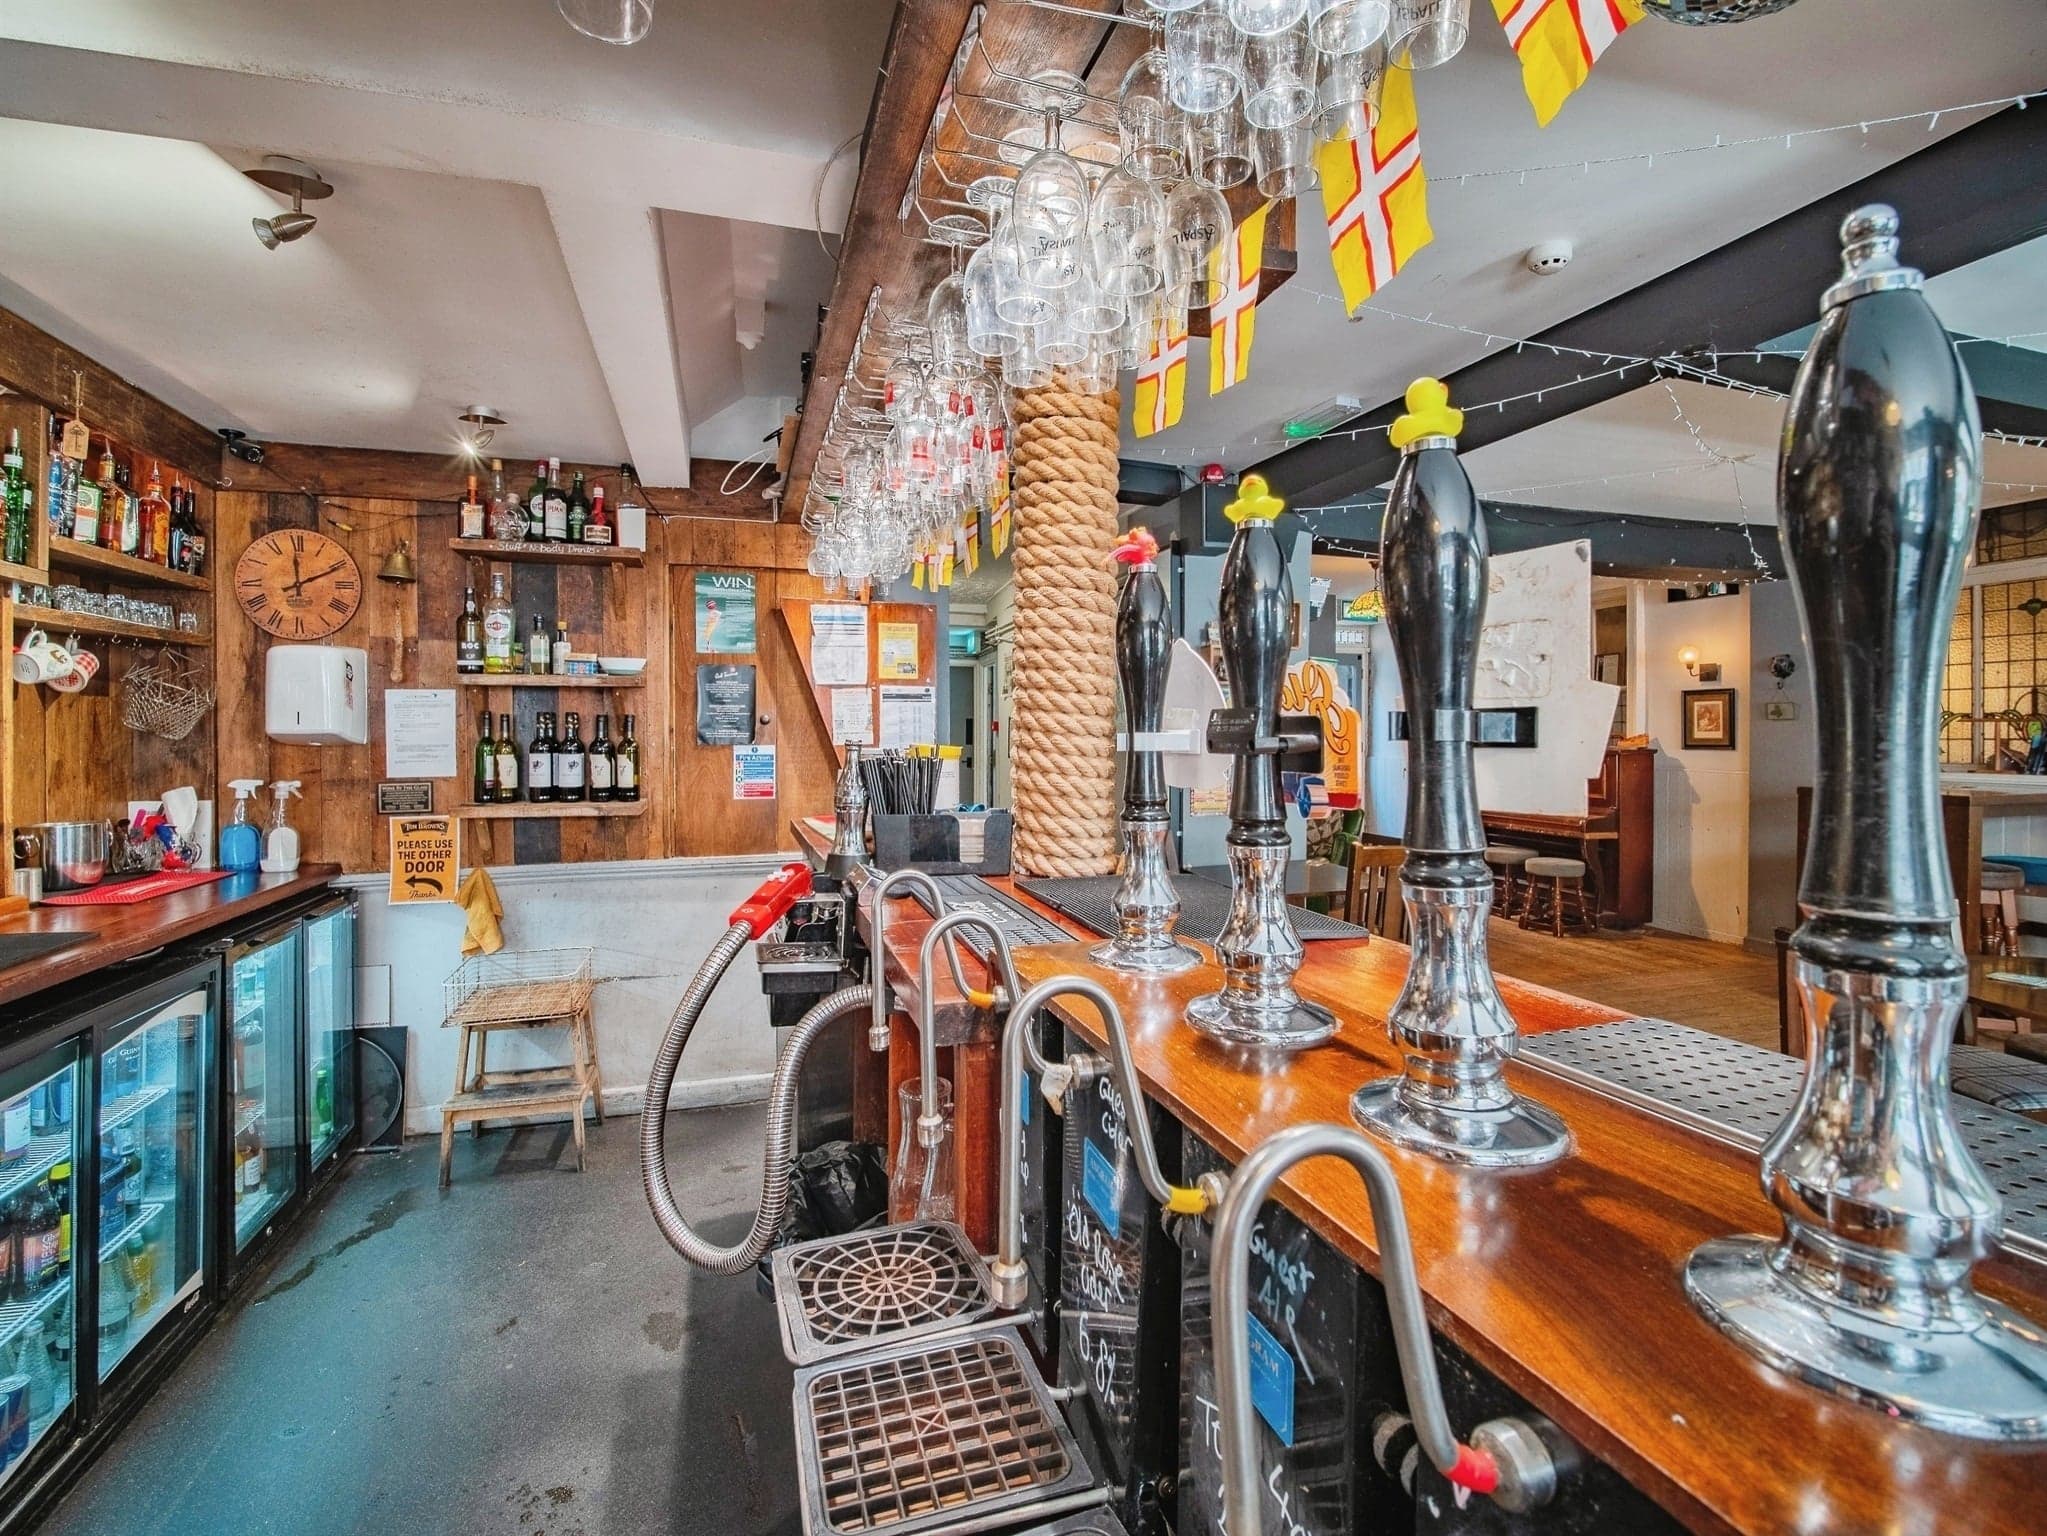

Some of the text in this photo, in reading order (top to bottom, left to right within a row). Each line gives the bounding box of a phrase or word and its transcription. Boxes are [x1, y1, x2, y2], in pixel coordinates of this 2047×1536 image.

[712, 576, 751, 588] WIN
[397, 839, 453, 849] PLEASE USE
[398, 850, 452, 860] THE OTHER
[404, 861, 445, 873] DOOR
[409, 890, 436, 899] Thanks
[1100, 1076, 1126, 1121] Gues
[1250, 1224, 1315, 1295] Guest
